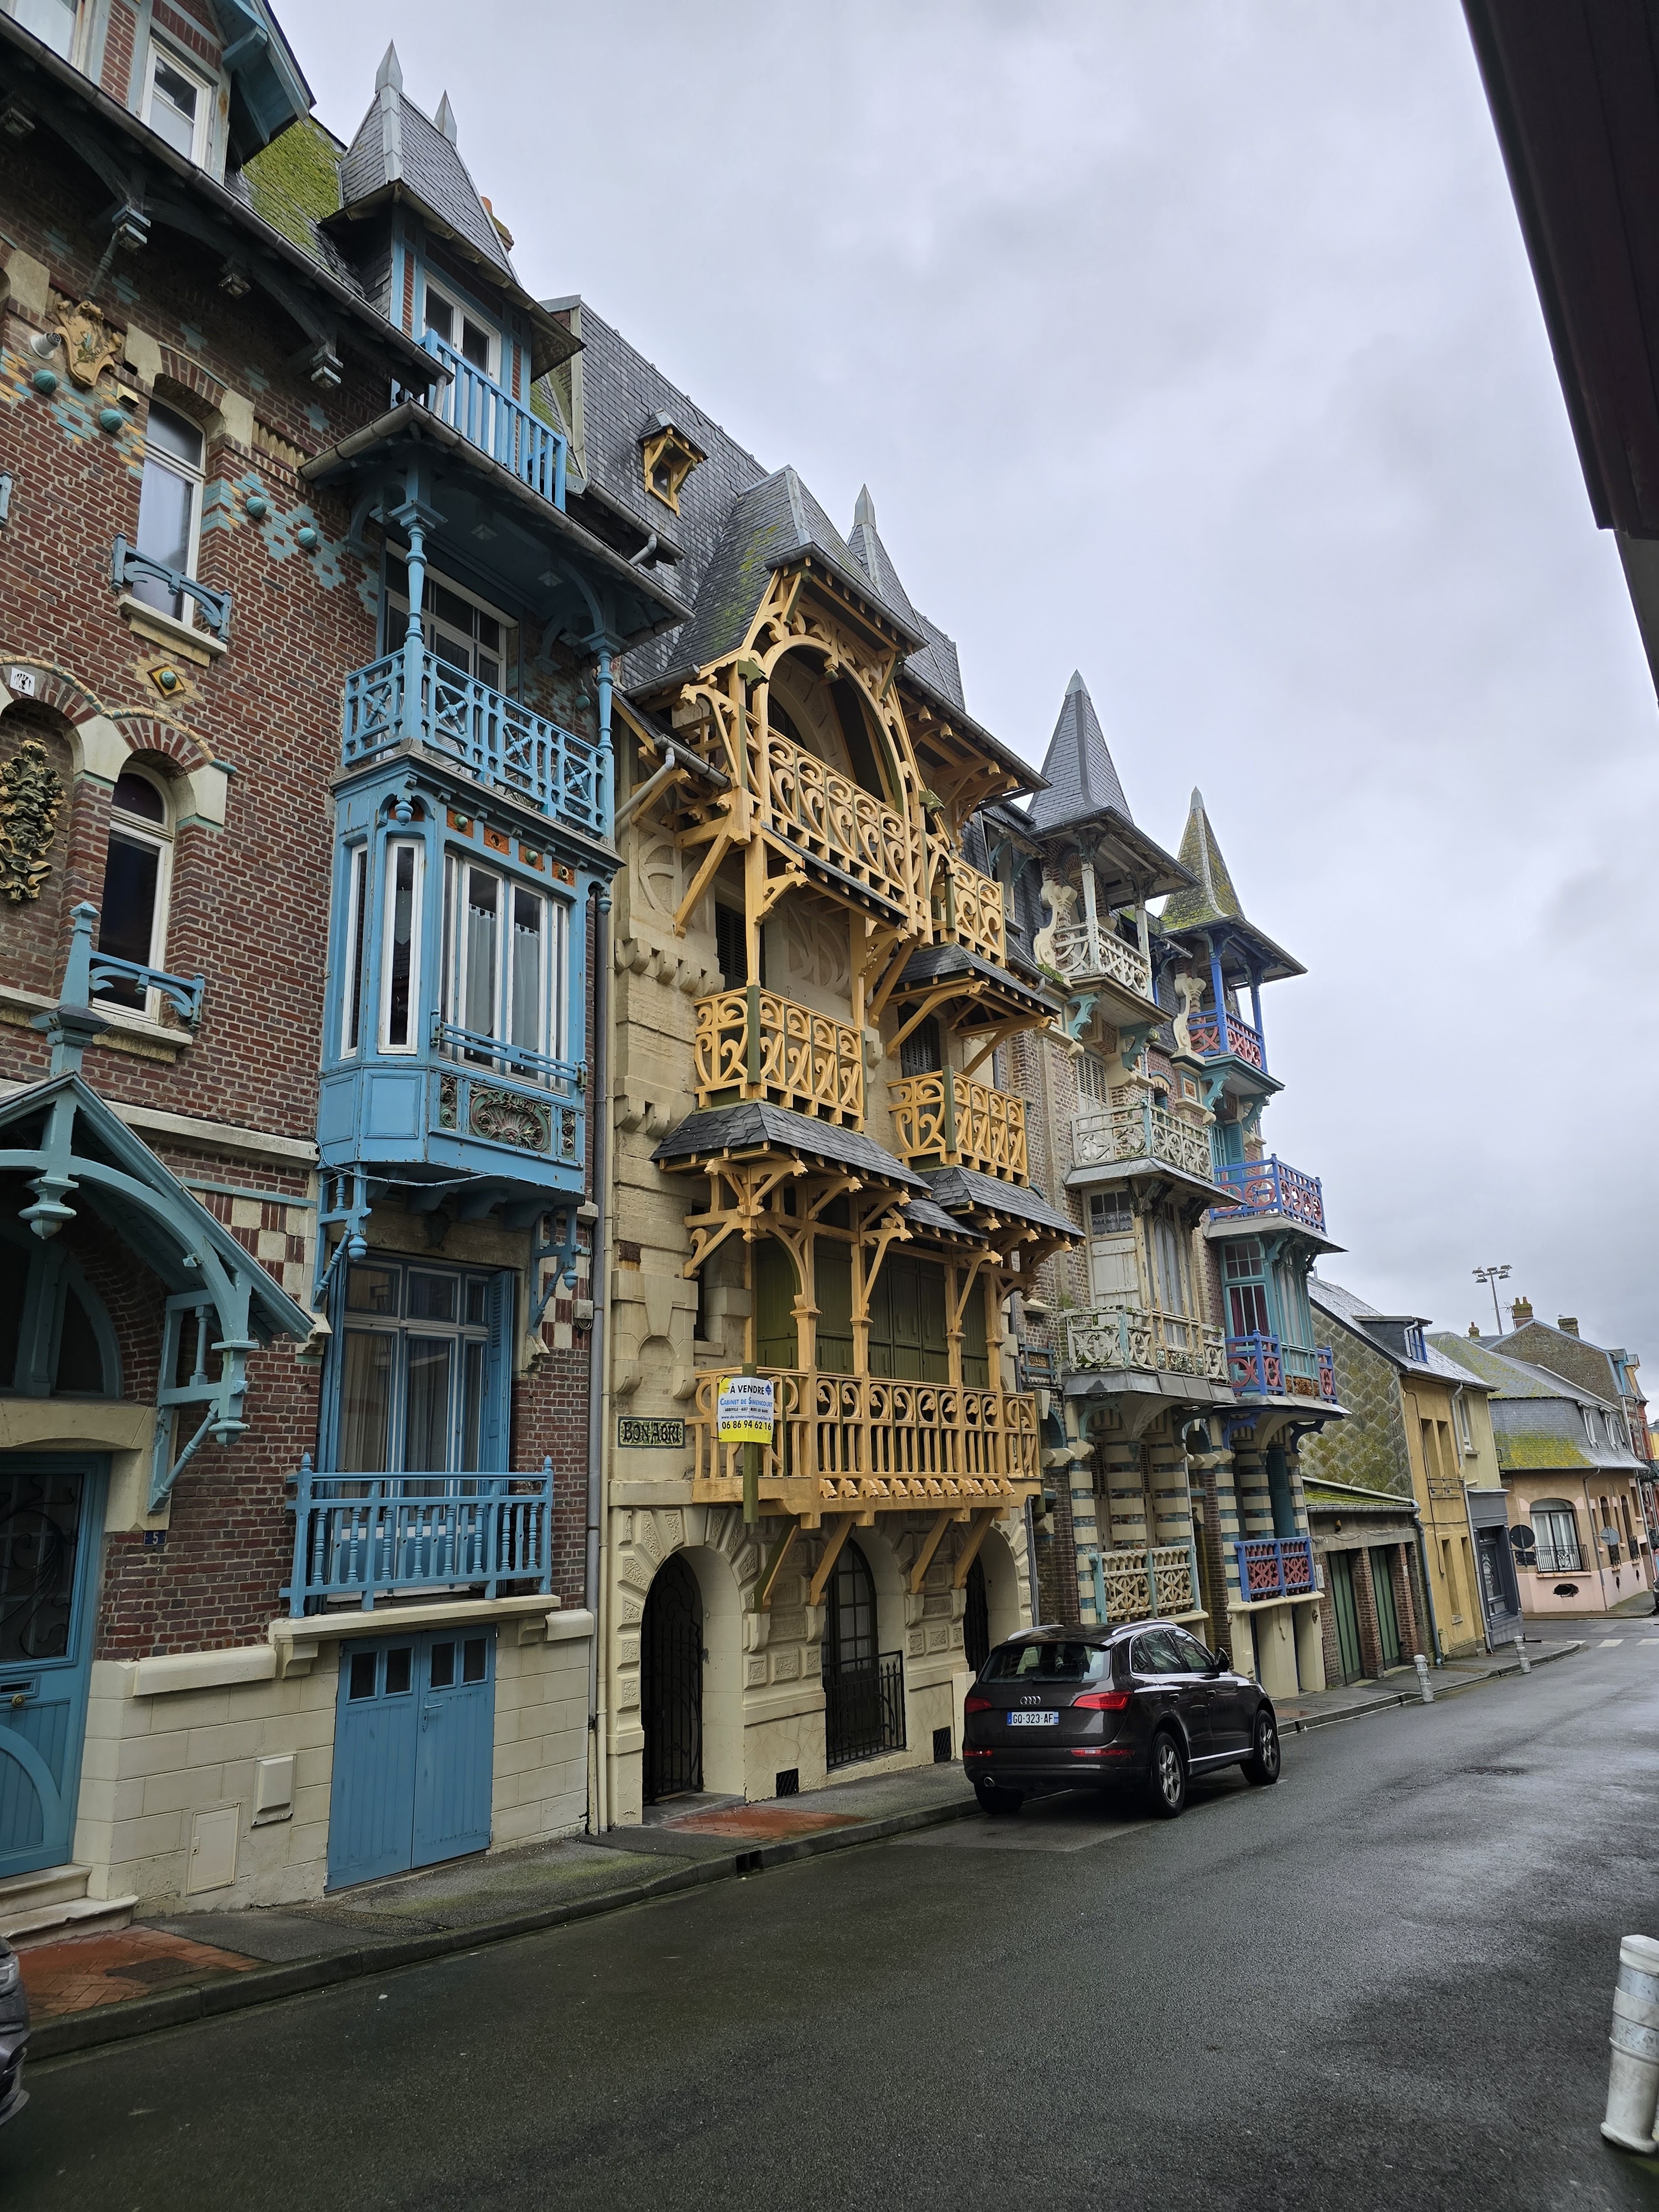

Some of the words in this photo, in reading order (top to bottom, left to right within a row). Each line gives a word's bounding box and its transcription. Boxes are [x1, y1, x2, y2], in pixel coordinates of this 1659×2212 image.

[730, 1383, 735, 1394] À
[738, 1385, 764, 1395] VENDRE
[749, 1397, 773, 1407] SIMENCOURT
[733, 1420, 742, 1428] 86
[744, 1420, 753, 1428] 94
[754, 1421, 763, 1430] 62
[764, 1422, 771, 1431] 16
[623, 1421, 650, 1442] BON
[651, 1422, 680, 1444] ABRI
[153, 1532, 159, 1545] 5
